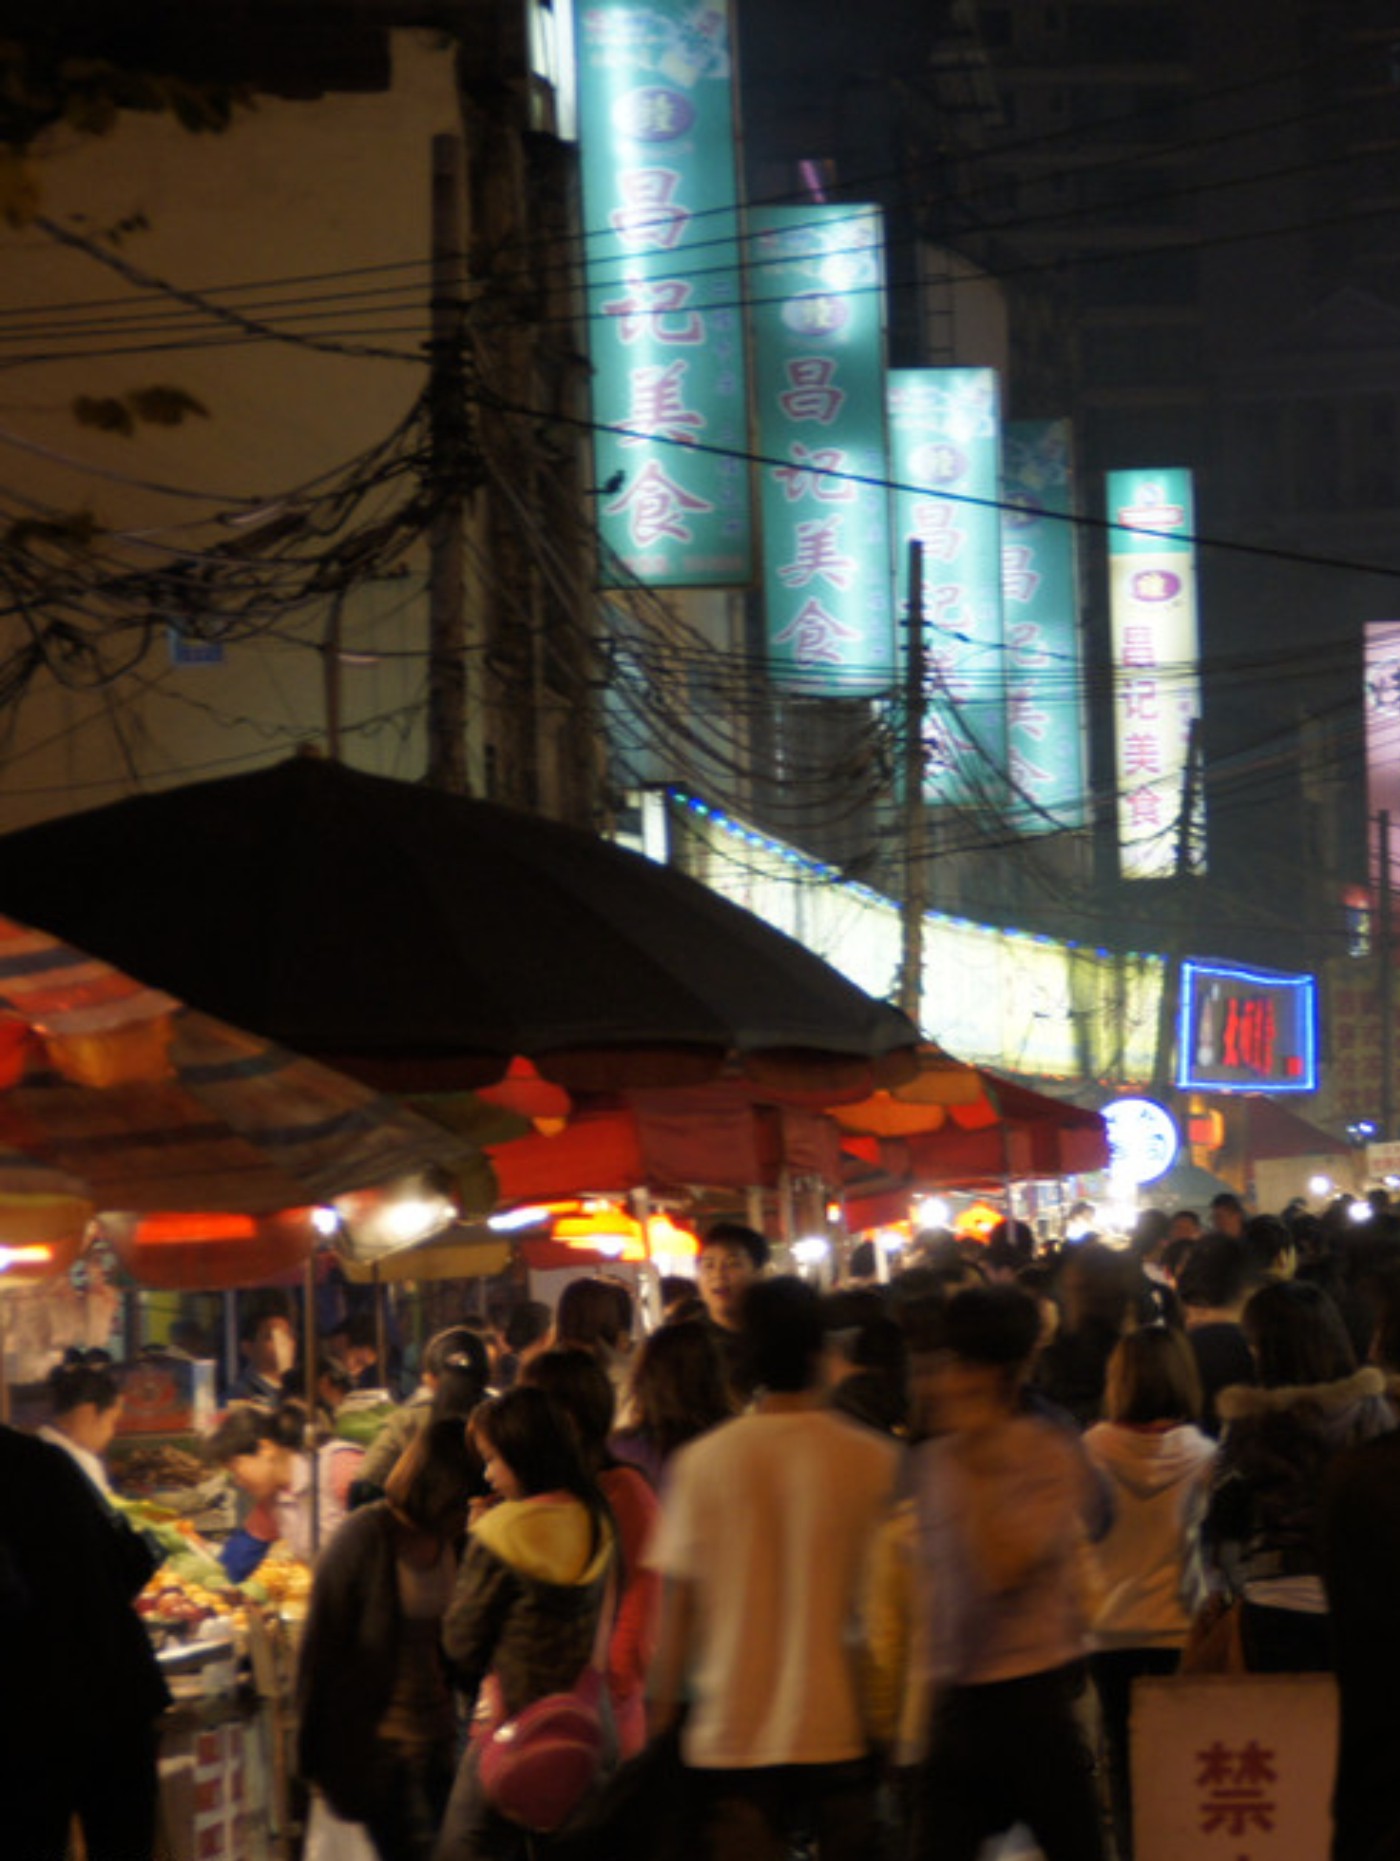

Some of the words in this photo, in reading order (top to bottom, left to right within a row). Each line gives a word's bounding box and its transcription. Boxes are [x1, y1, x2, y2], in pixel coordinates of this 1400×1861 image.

[602, 167, 714, 548] 昌记美食
[772, 357, 863, 664] 昌记美食
[1121, 626, 1162, 827] 昌记美食
